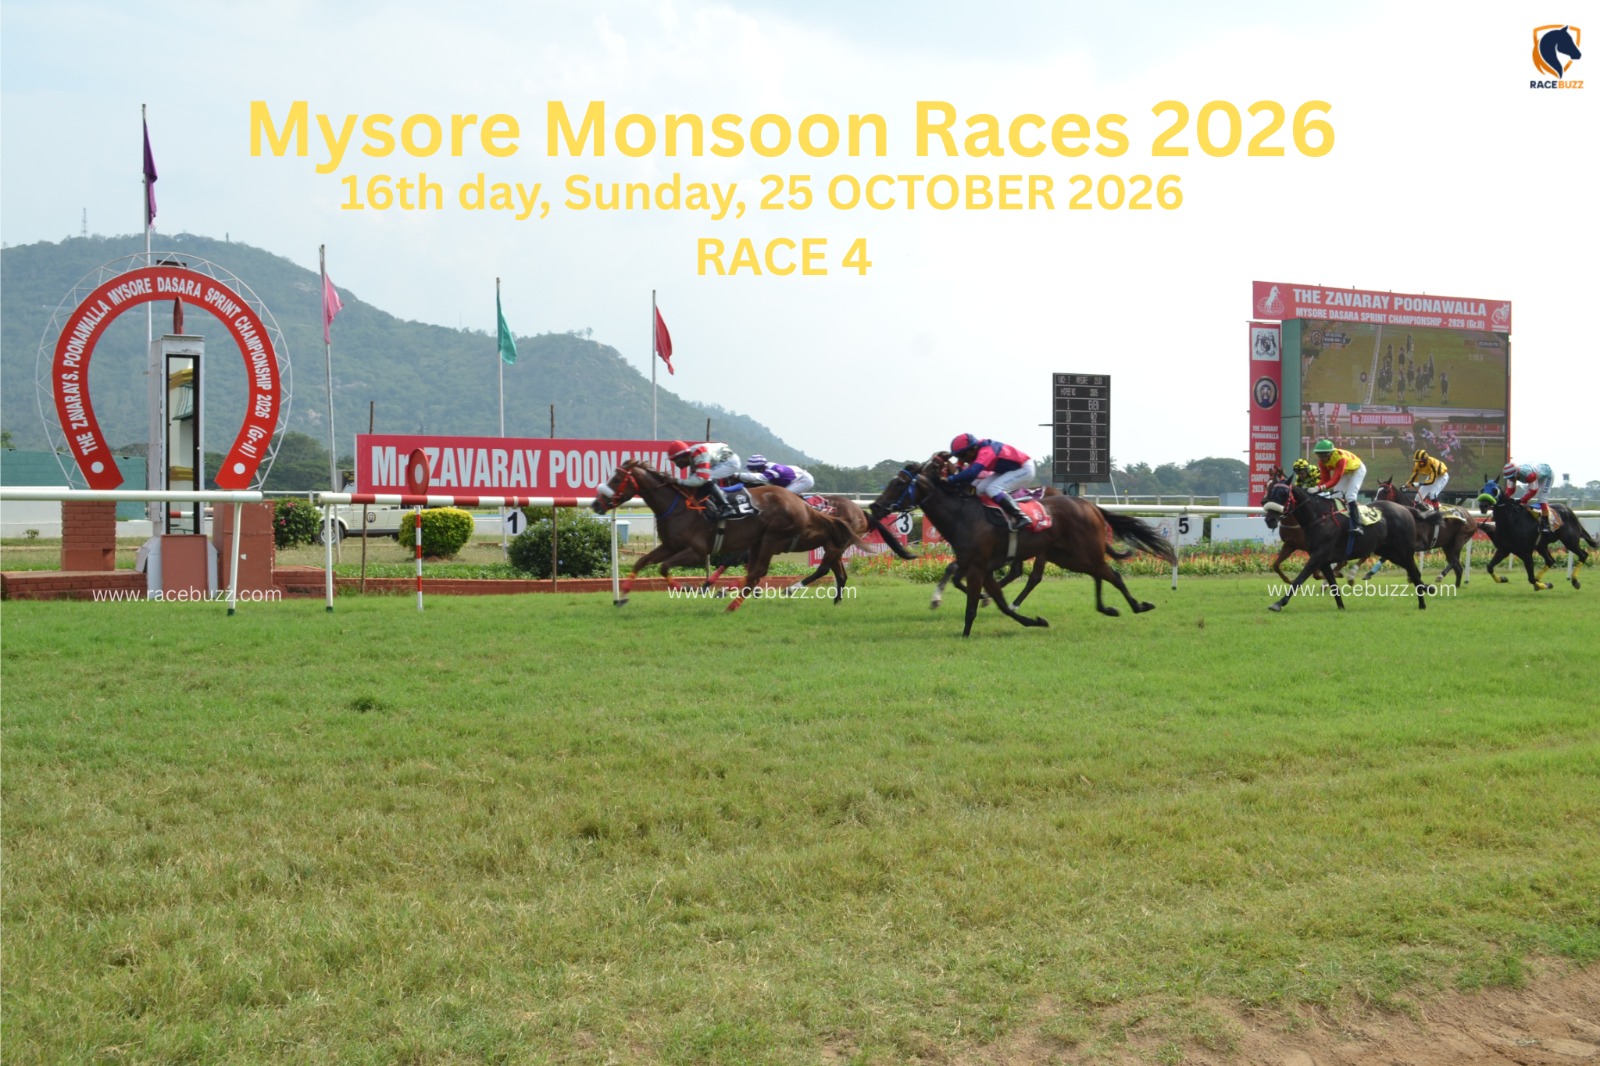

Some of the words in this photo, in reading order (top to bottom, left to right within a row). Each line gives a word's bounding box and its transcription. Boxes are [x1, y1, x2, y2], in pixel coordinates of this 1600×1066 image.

[107, 277, 153, 306] MYSORE
[157, 277, 201, 298] DASARA
[204, 288, 242, 319] SPRINT
[1293, 288, 1321, 304] THE
[1325, 291, 1390, 310] ZAVARAY
[1394, 296, 1487, 316] POONAWALLA
[1296, 307, 1327, 318] MYSORE
[1329, 309, 1359, 321] DASARA
[1360, 312, 1387, 323] SPRINT
[1388, 314, 1442, 326] CHAMPIONSHIP
[63, 300, 112, 368] POONAWALLA
[234, 316, 272, 390] CHAMPIONSHIP
[63, 371, 80, 382] S.
[64, 383, 89, 430] ZAVARAY
[254, 394, 272, 419] 2026
[76, 431, 98, 456] THE
[1255, 442, 1276, 451] MYSORE
[423, 447, 542, 488] ZAVARAY
[1255, 452, 1276, 461] DASARA
[507, 511, 517, 534] 1
[899, 511, 910, 533] 3
[1178, 517, 1189, 534] 5
